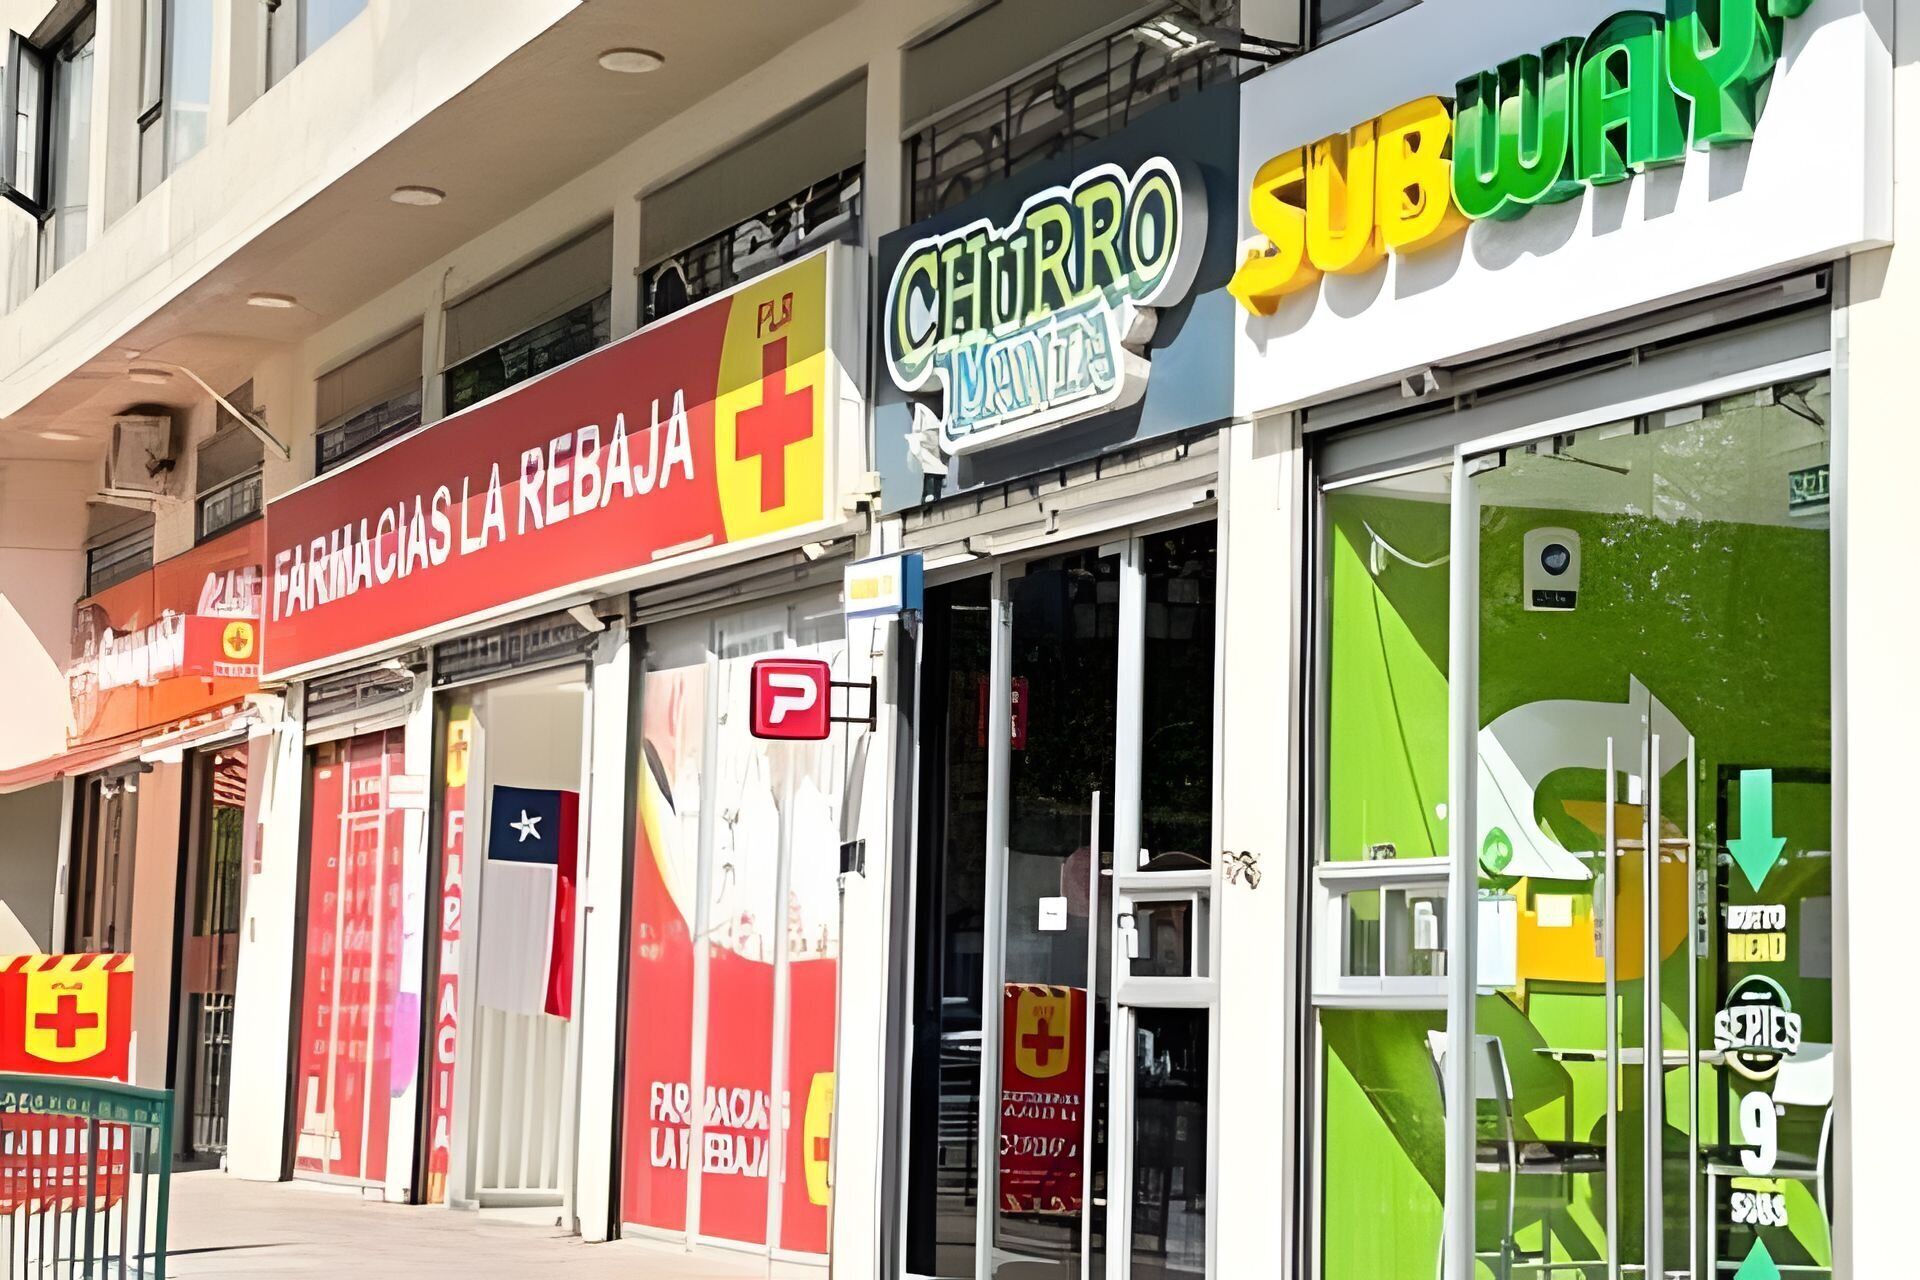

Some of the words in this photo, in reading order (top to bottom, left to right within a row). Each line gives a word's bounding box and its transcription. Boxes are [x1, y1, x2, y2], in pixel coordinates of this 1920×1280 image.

[1227, 0, 1800, 317] SUBWAY
[893, 168, 1180, 368] CHURRO
[272, 484, 452, 622] FARMACIAS
[459, 462, 507, 556] LA
[517, 388, 695, 536] REBAJA
[767, 672, 818, 725] P
[1740, 1091, 1777, 1175] 9
